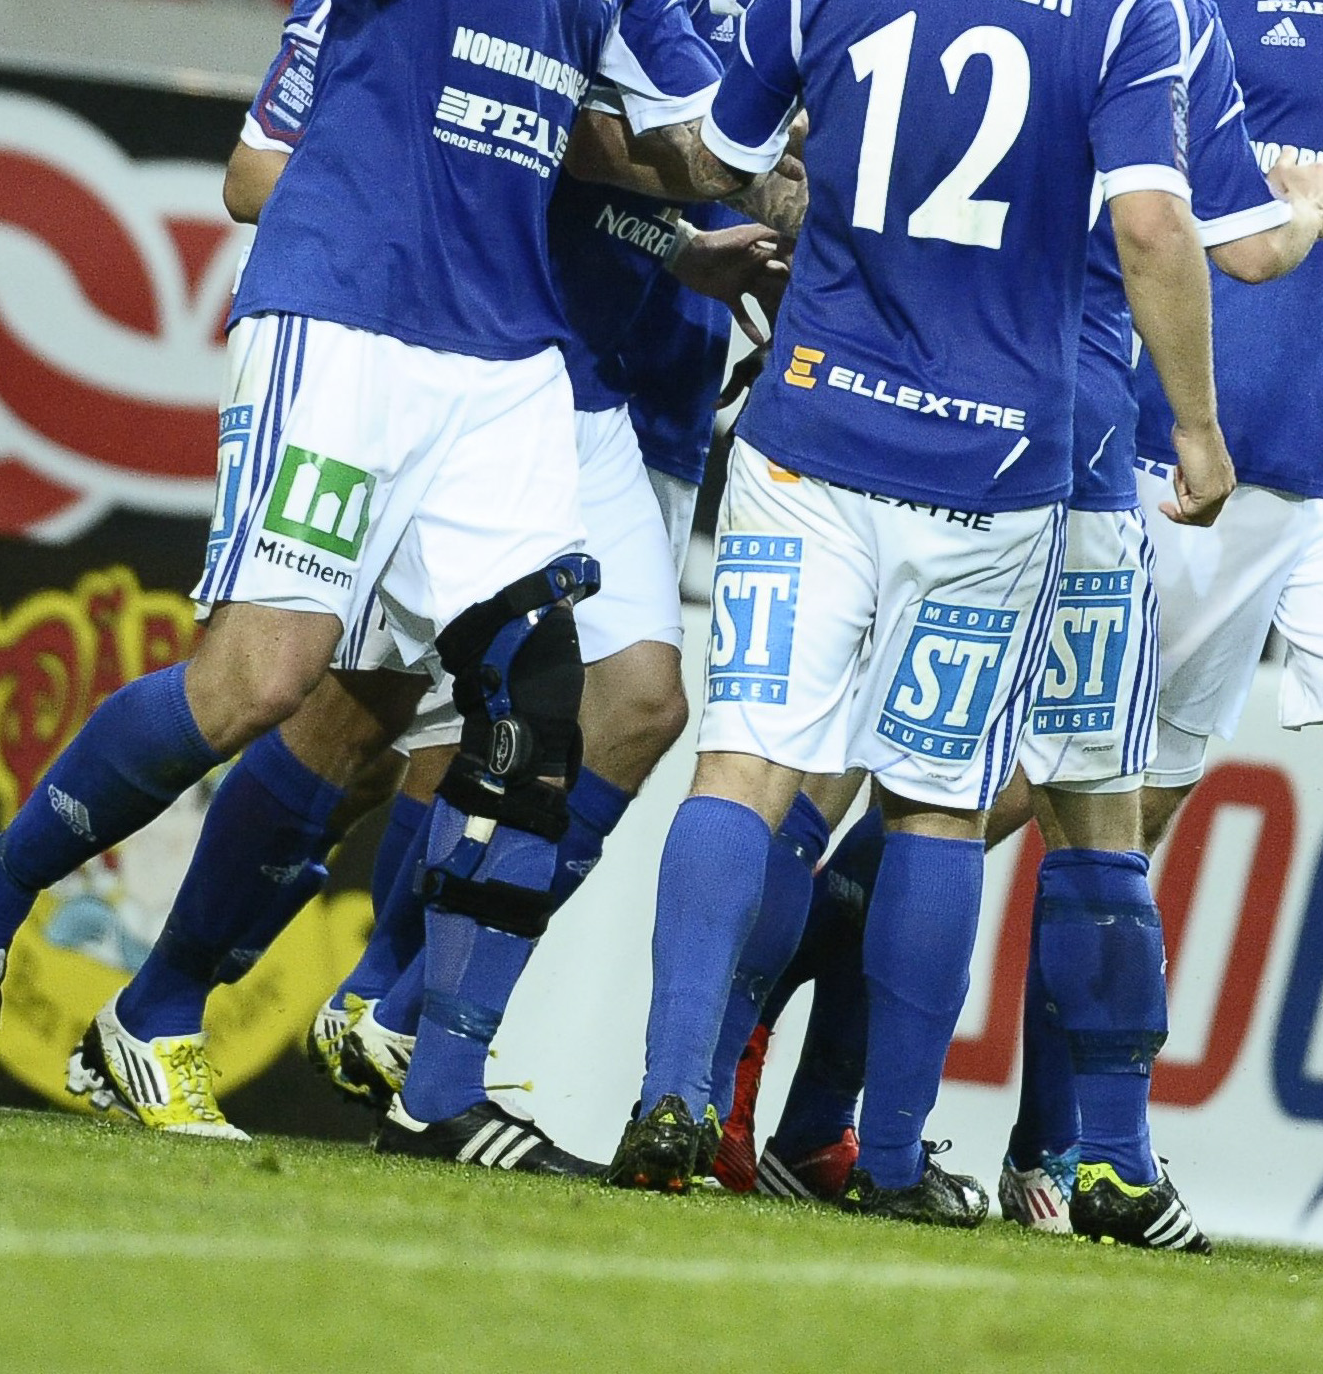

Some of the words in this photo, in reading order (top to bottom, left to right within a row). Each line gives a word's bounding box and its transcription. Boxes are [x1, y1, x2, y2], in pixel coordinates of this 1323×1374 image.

[1260, 35, 1306, 47] adidas
[432, 126, 493, 156] NORDENS
[847, 10, 1031, 250] 12
[827, 365, 1027, 431] ELLEXTRE
[253, 536, 353, 591] Mitthem
[1059, 576, 1130, 592] MEDIE
[710, 570, 791, 667] ST
[924, 605, 1013, 629] MEDIE
[1042, 605, 1126, 700] ST
[892, 633, 1002, 728] ST
[882, 719, 972, 755] HUSET
[1036, 711, 1111, 729] HUSET
